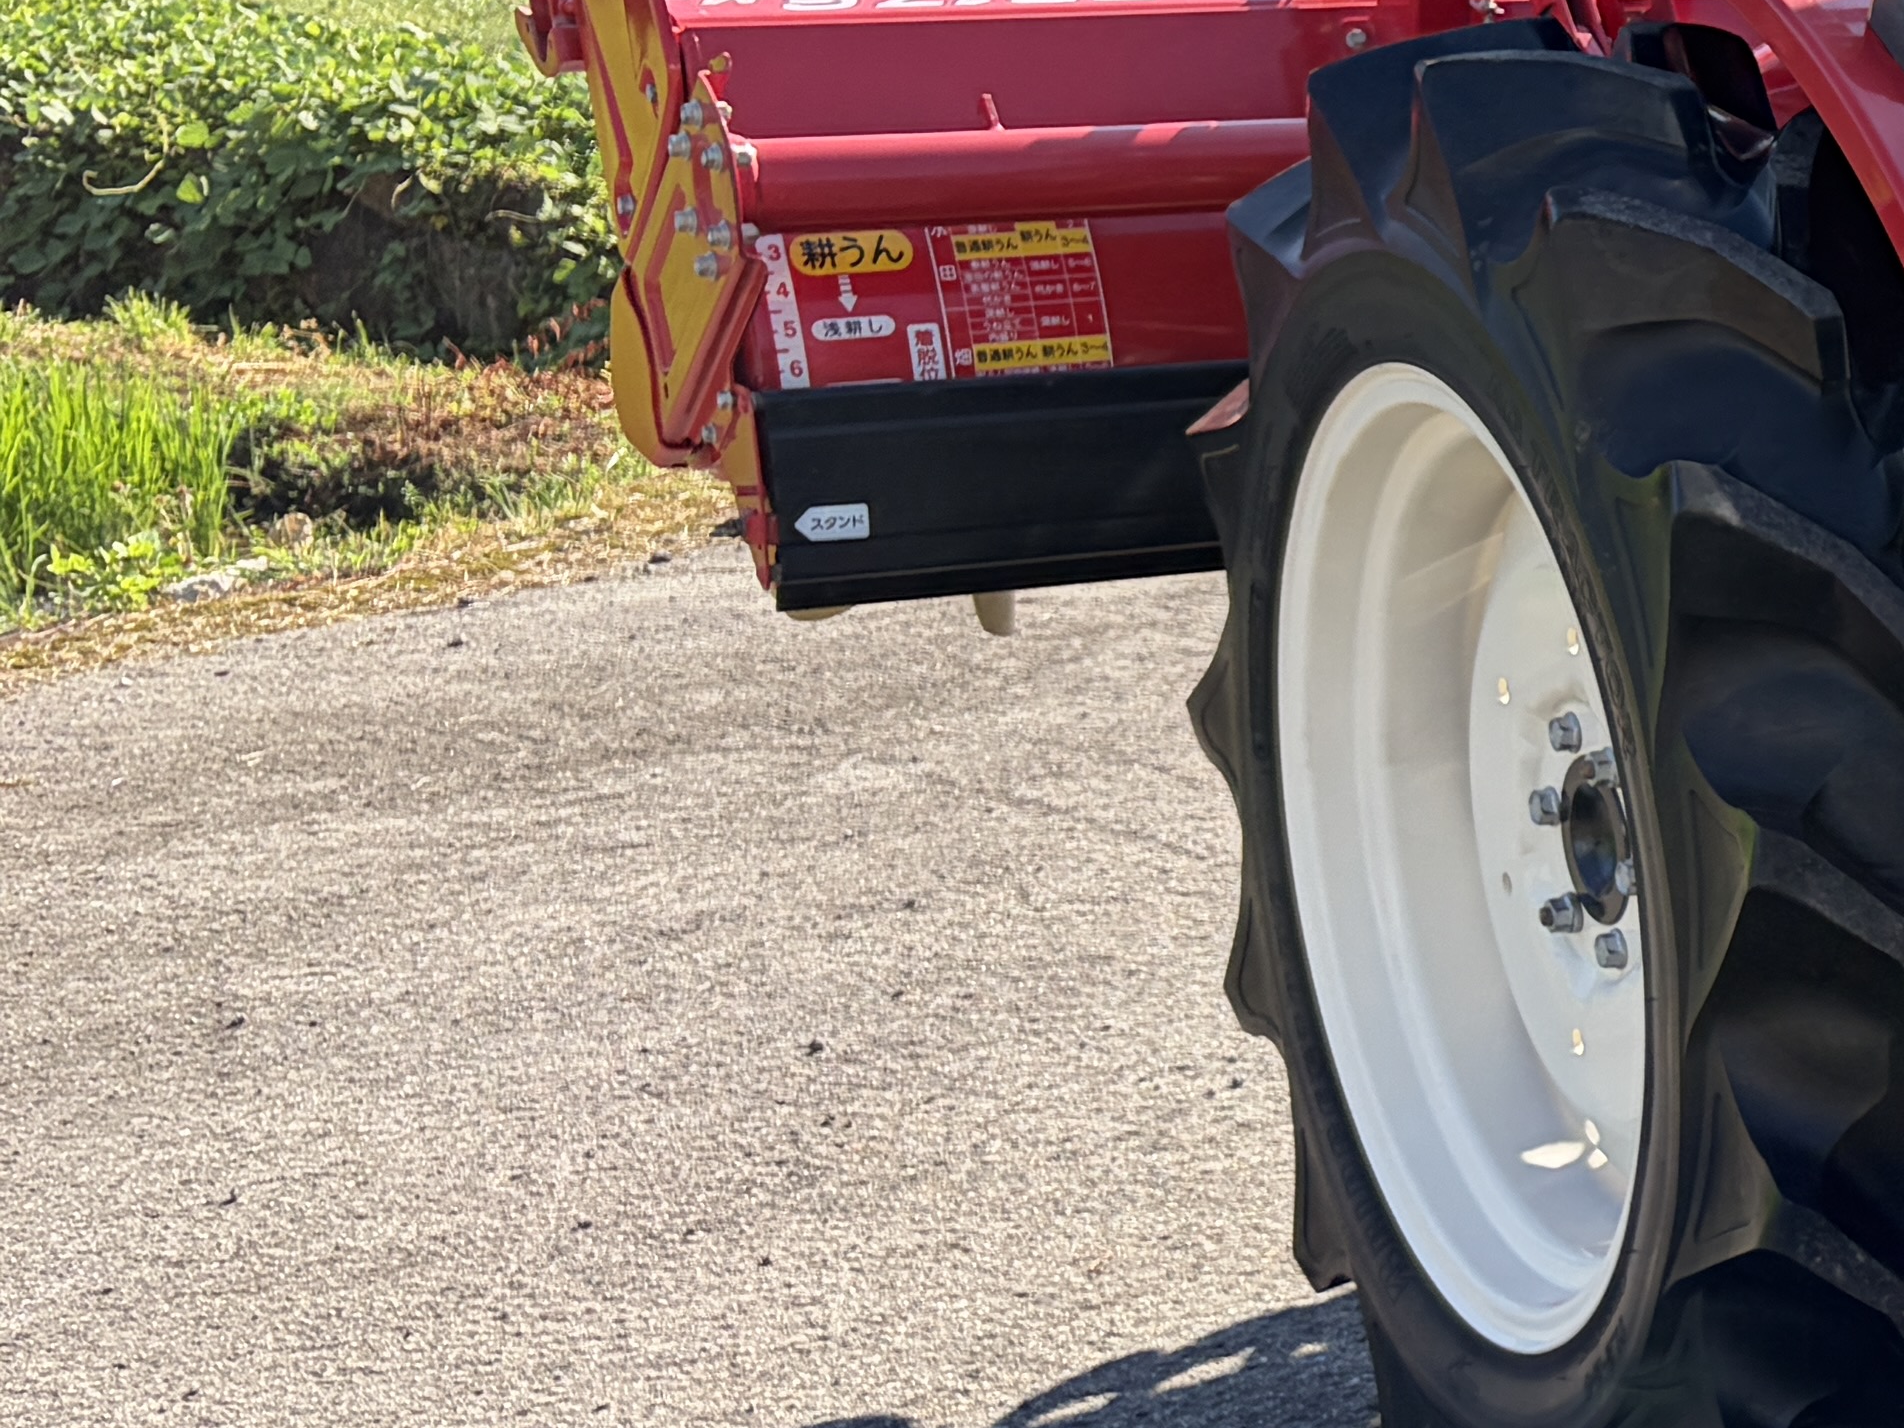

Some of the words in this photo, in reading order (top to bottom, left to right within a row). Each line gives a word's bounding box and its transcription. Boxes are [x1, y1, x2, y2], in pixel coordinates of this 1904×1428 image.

[767, 243, 782, 262] 3
[800, 235, 905, 270] 耕うん
[776, 281, 791, 299] 4
[783, 320, 798, 338] 5
[789, 360, 804, 378] 6
[810, 513, 865, 532] スタンド
